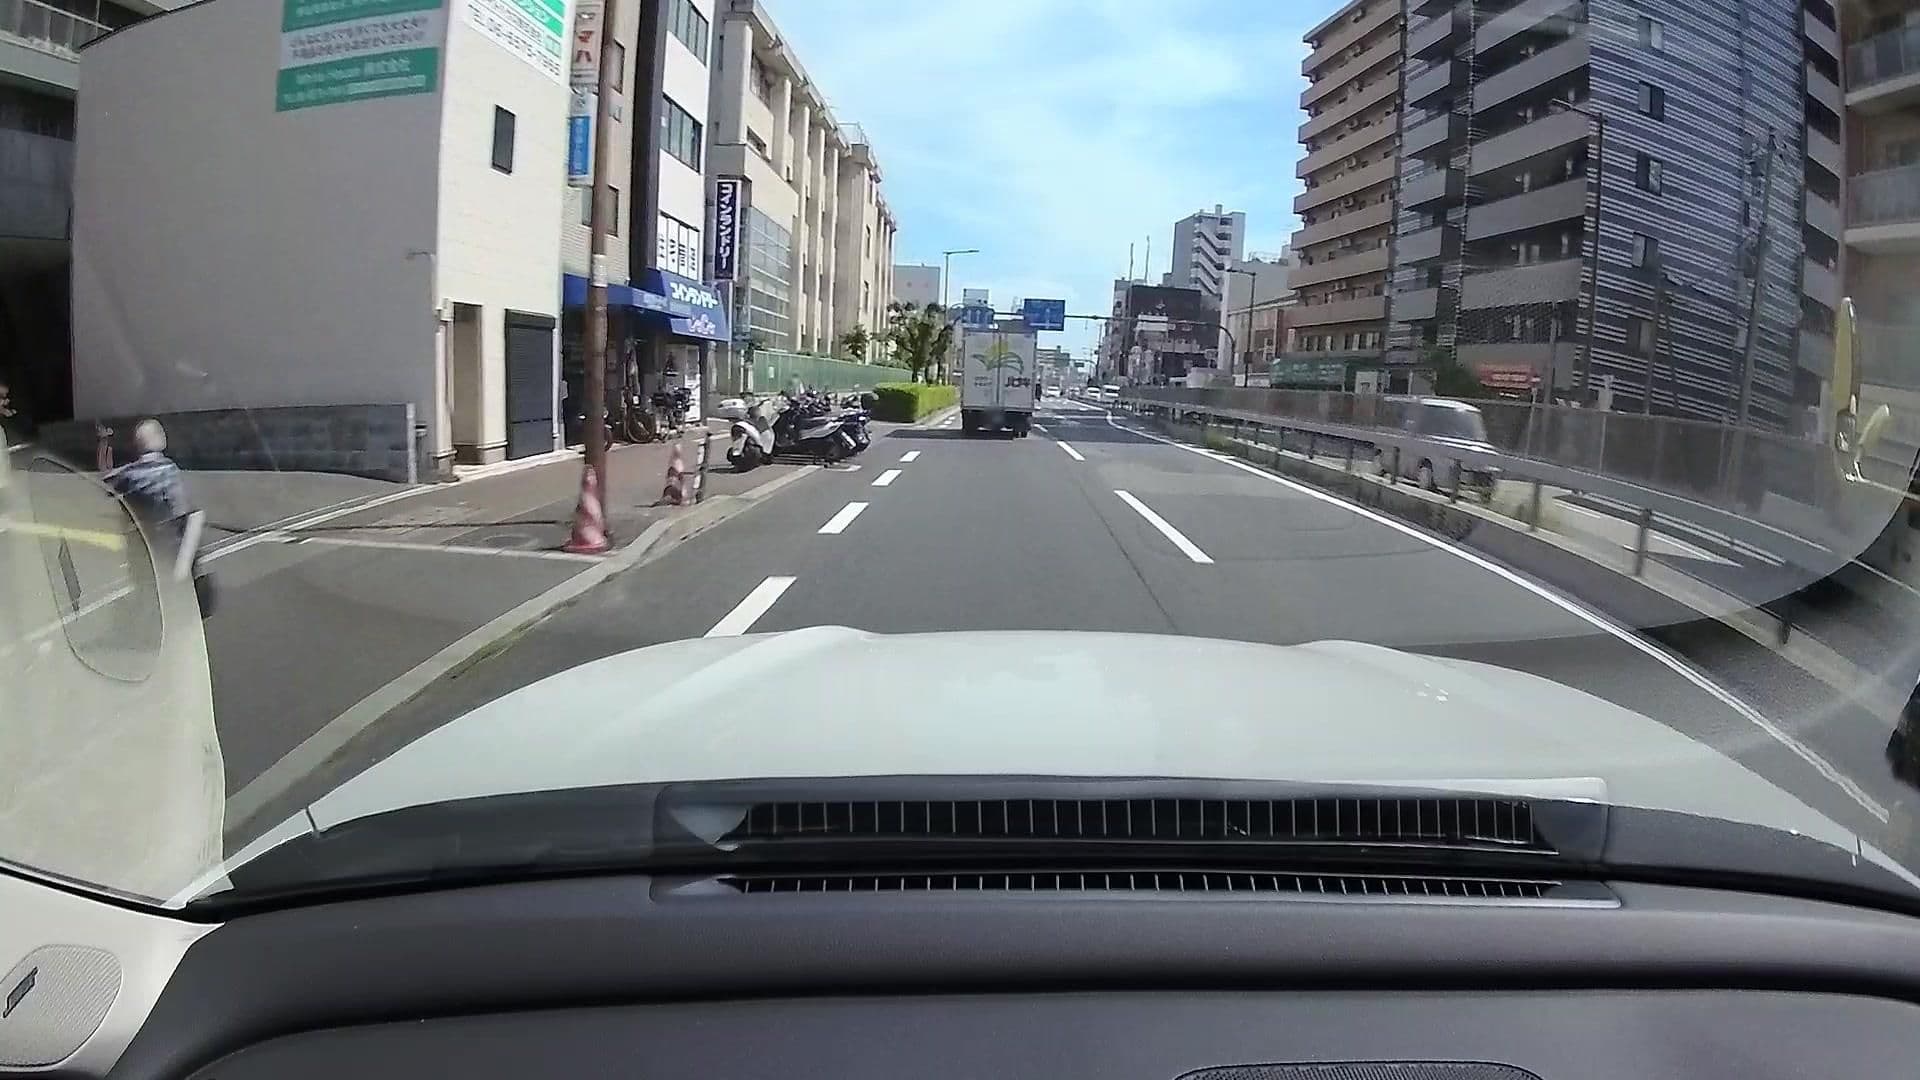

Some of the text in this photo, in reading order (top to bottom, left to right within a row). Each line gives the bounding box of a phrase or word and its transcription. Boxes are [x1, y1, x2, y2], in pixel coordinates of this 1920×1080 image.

[720, 183, 733, 269] コインランドリー
